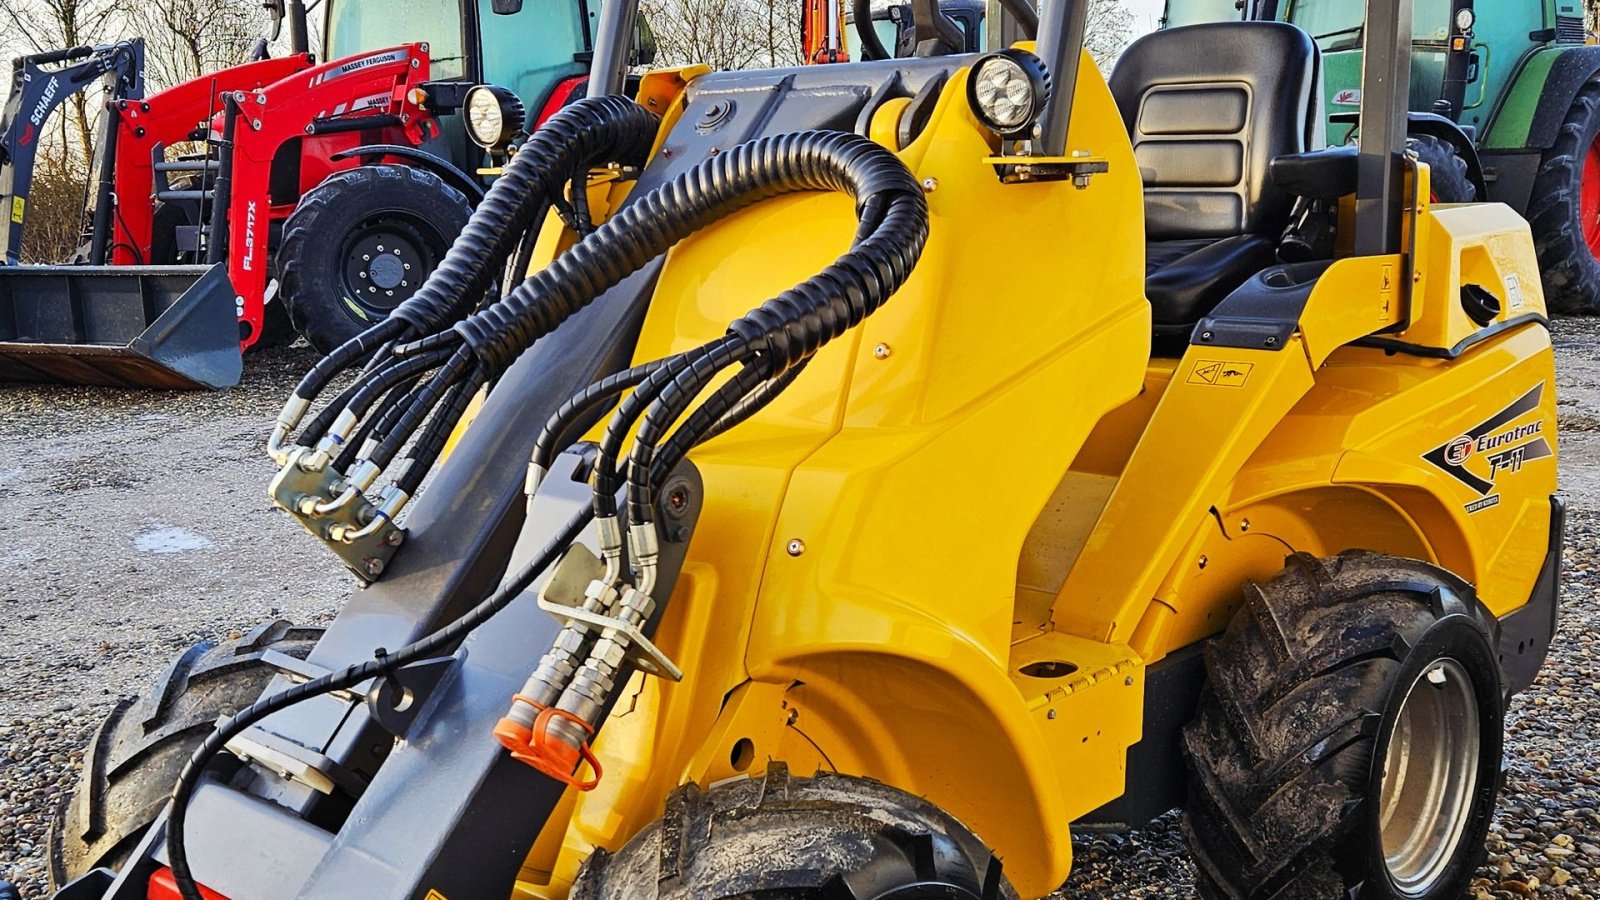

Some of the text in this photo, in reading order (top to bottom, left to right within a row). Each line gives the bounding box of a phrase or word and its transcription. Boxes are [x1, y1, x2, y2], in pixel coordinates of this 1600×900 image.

[341, 55, 396, 73] MASSEY FERGUSON
[30, 75, 59, 126] SCHAEFF
[367, 95, 389, 106] MASSEY
[1476, 420, 1542, 452] Eurotrac
[1489, 447, 1524, 480] T-11
